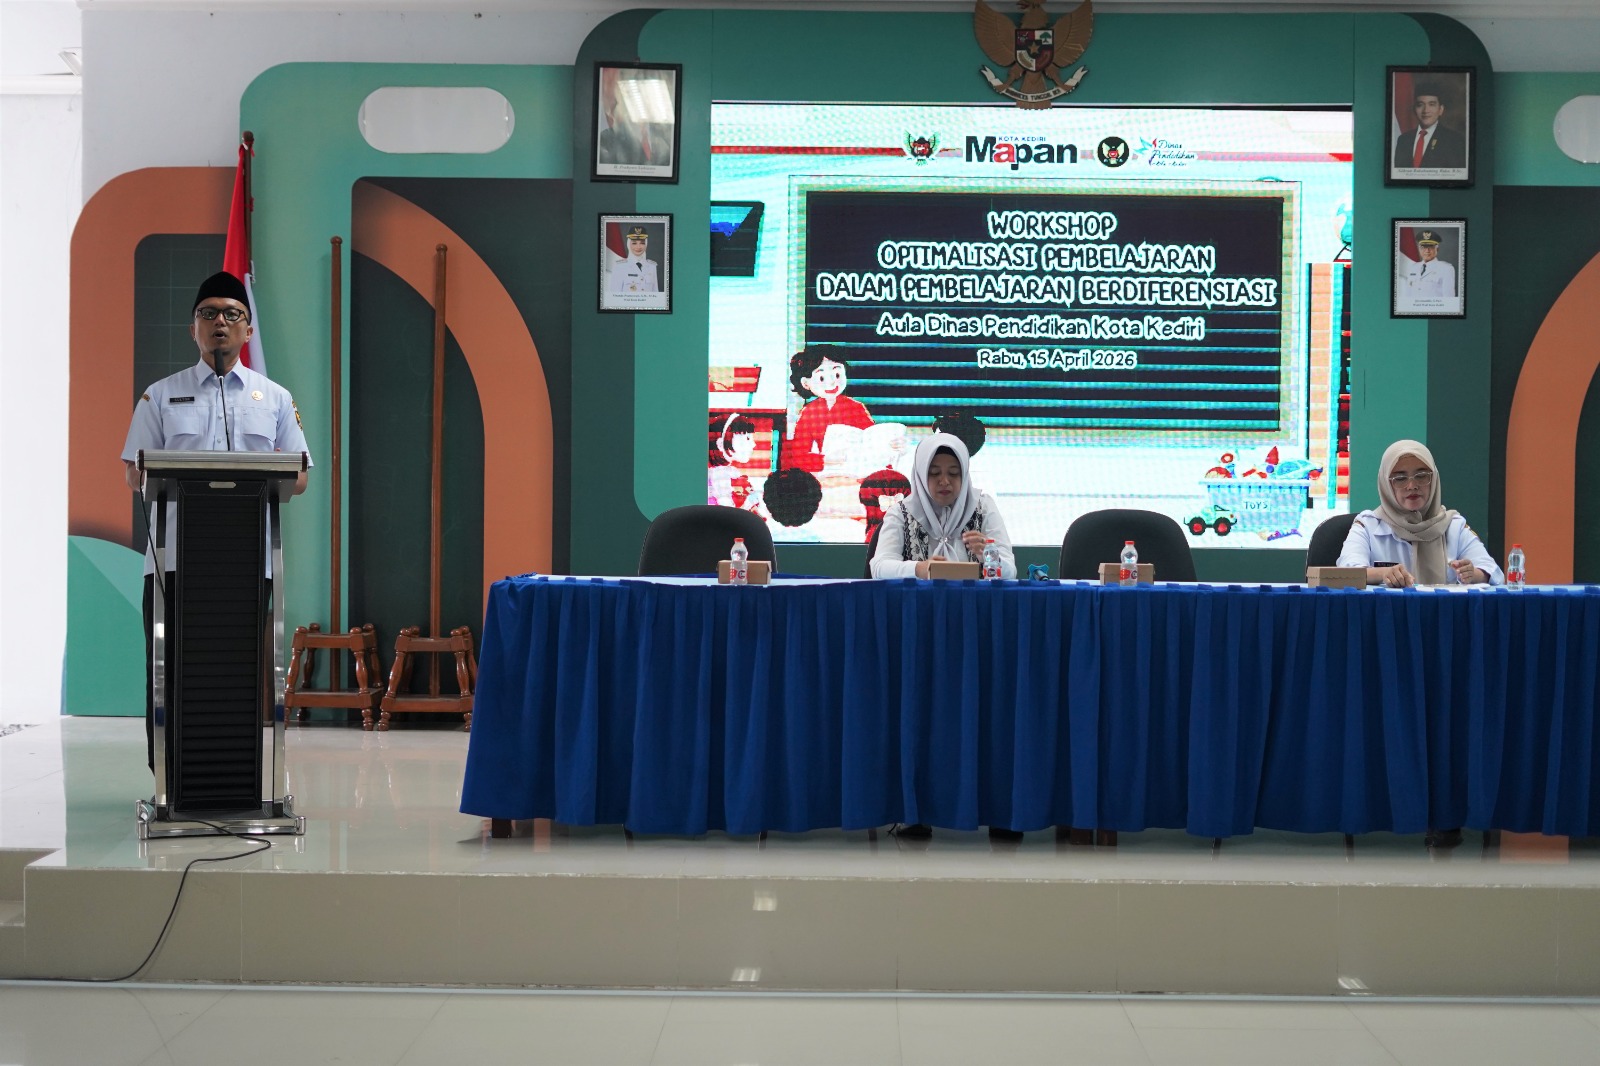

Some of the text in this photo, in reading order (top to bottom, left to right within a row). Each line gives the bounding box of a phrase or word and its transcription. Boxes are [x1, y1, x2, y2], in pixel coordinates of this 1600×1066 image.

[965, 136, 1078, 171] Mapan
[989, 213, 1114, 237] WORKSHOP
[880, 243, 1213, 272] OPTIMALISASI PEMBELAJARAN
[819, 275, 1275, 304] DALAM PEMBELAJARAN BERDIFERENSIASI
[877, 314, 1205, 338] Aula Dinas Pendidikan Kota Kediri
[979, 351, 1135, 369] Rabu, 15 April 2026
[1245, 501, 1268, 509] TOYS
